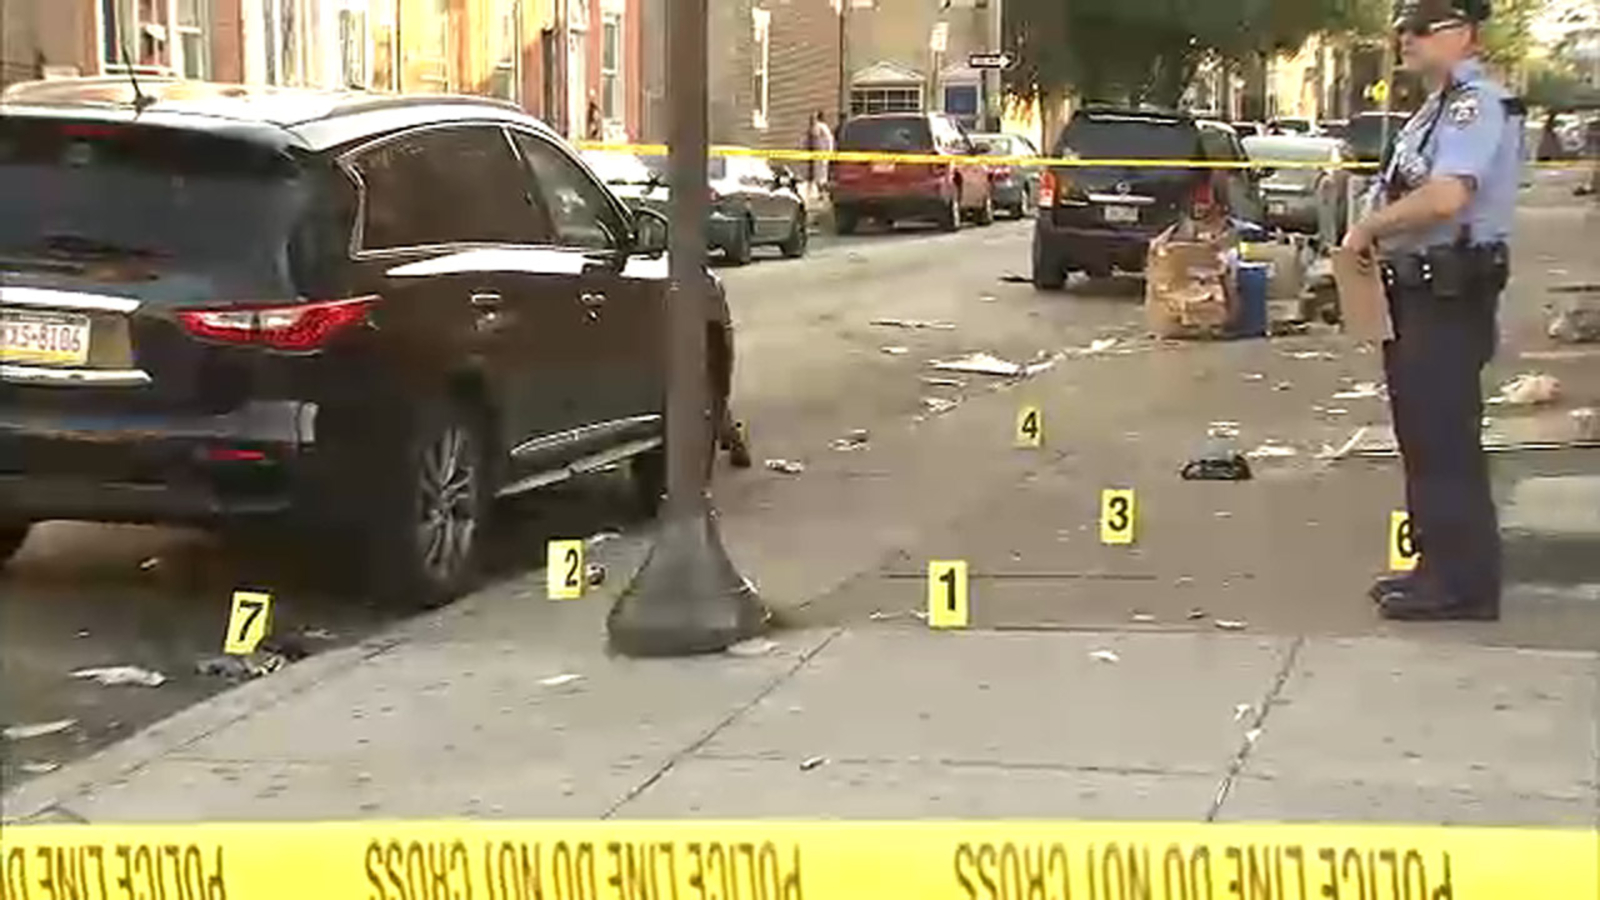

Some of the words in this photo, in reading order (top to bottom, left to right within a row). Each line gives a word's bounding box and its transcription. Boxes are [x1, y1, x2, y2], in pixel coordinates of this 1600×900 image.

[1021, 411, 1038, 439] 4
[1108, 496, 1129, 532] 3
[1397, 519, 1416, 558] 6
[565, 548, 578, 587] 2
[939, 567, 956, 611] 1
[238, 599, 264, 642] 7
[0, 846, 28, 900] D
